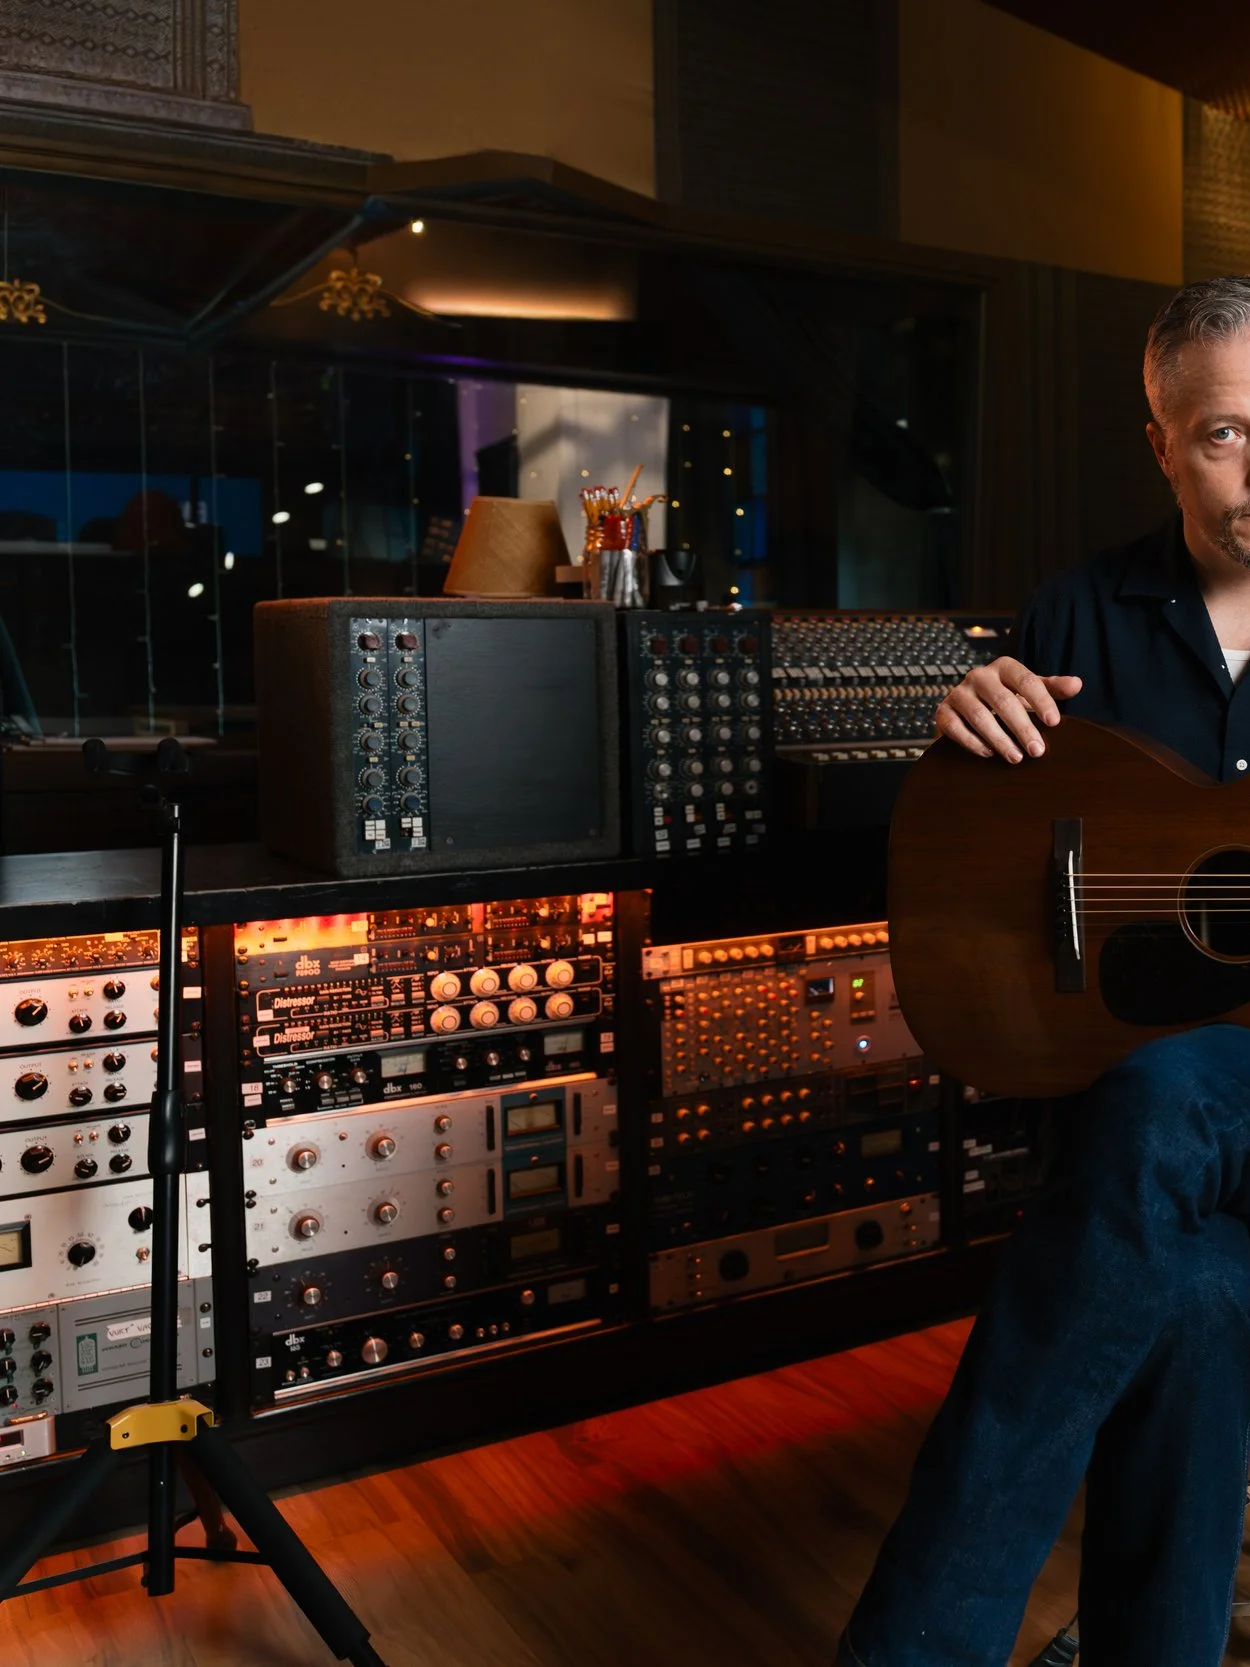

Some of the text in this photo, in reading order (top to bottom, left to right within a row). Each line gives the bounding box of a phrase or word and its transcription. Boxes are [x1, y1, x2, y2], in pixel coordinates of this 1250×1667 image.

[295, 954, 321, 970] dbx
[274, 996, 316, 1009] Distressor
[273, 1031, 315, 1044] Distressor
[19, 1062, 42, 1070] OUTPUT
[383, 1082, 402, 1094] dbx
[284, 1333, 305, 1346] dbx
